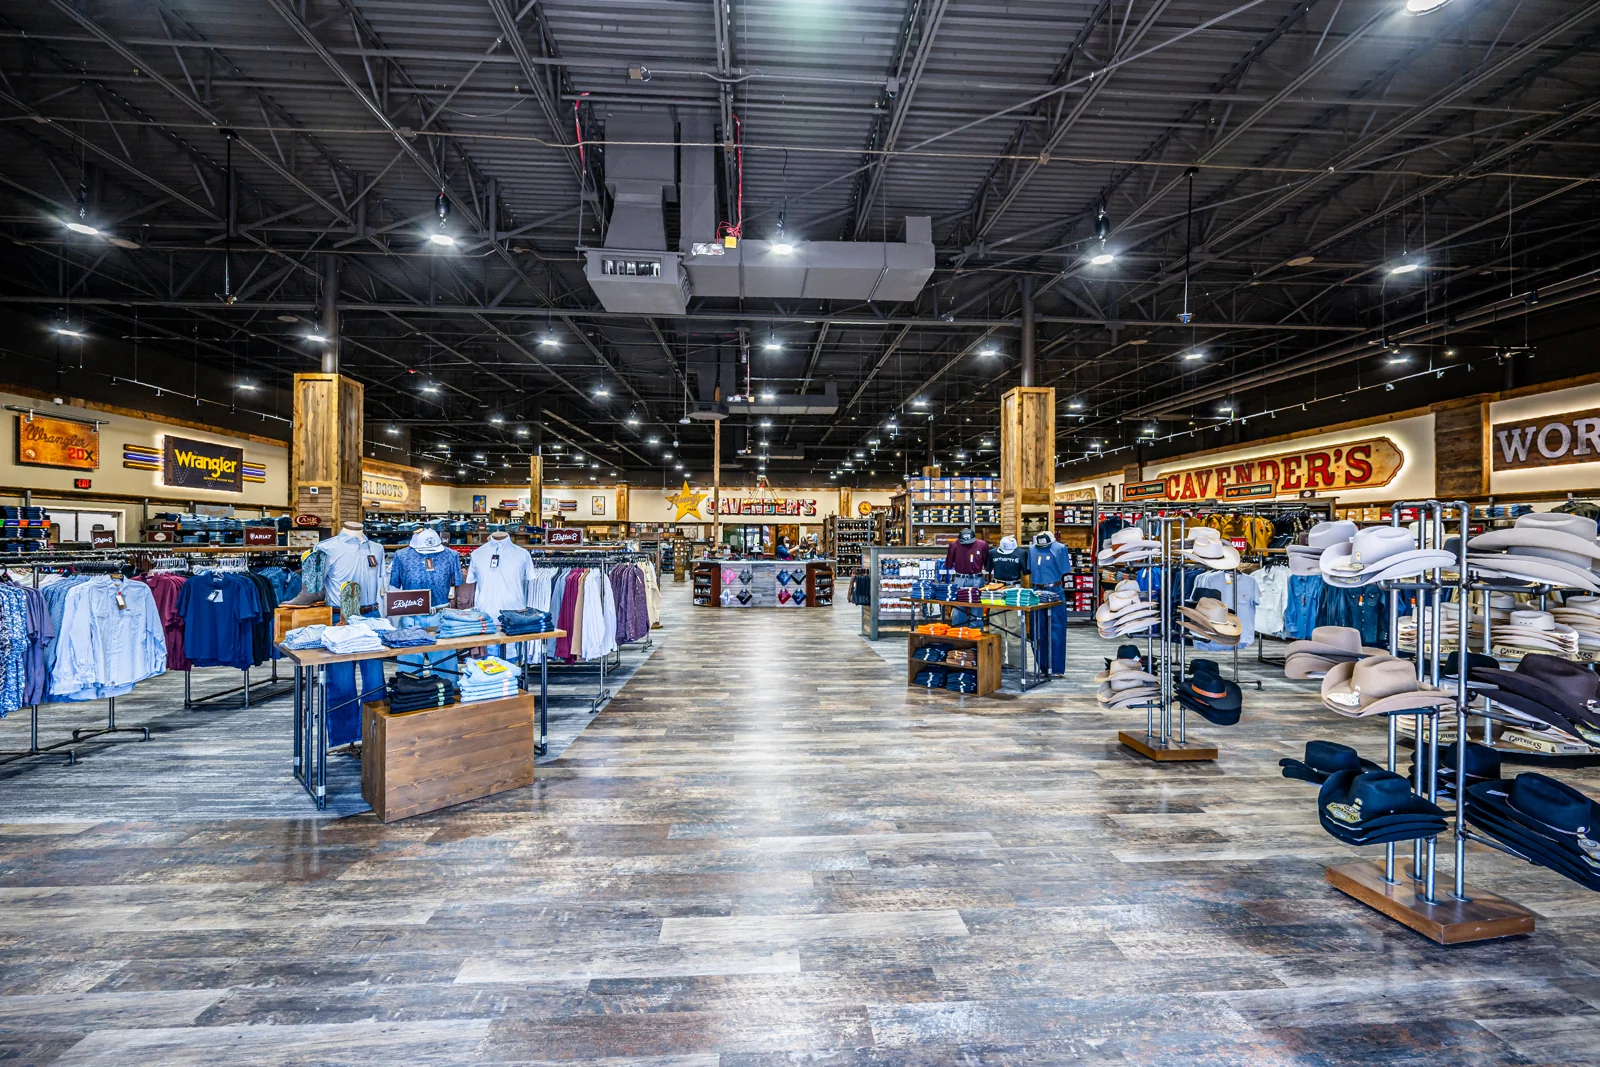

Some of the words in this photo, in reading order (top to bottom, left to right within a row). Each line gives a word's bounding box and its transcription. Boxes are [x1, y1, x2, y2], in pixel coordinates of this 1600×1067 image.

[25, 423, 90, 451] Wrangler
[1496, 417, 1600, 464] WOR
[67, 447, 94, 462] 20X
[174, 448, 237, 478] Wrangler
[78, 479, 89, 488] EXIT
[1166, 445, 1373, 501] CAVENDER'S
[362, 480, 375, 494] RL
[376, 481, 403, 498] BOOTS
[706, 498, 817, 516] CAVENDER'S
